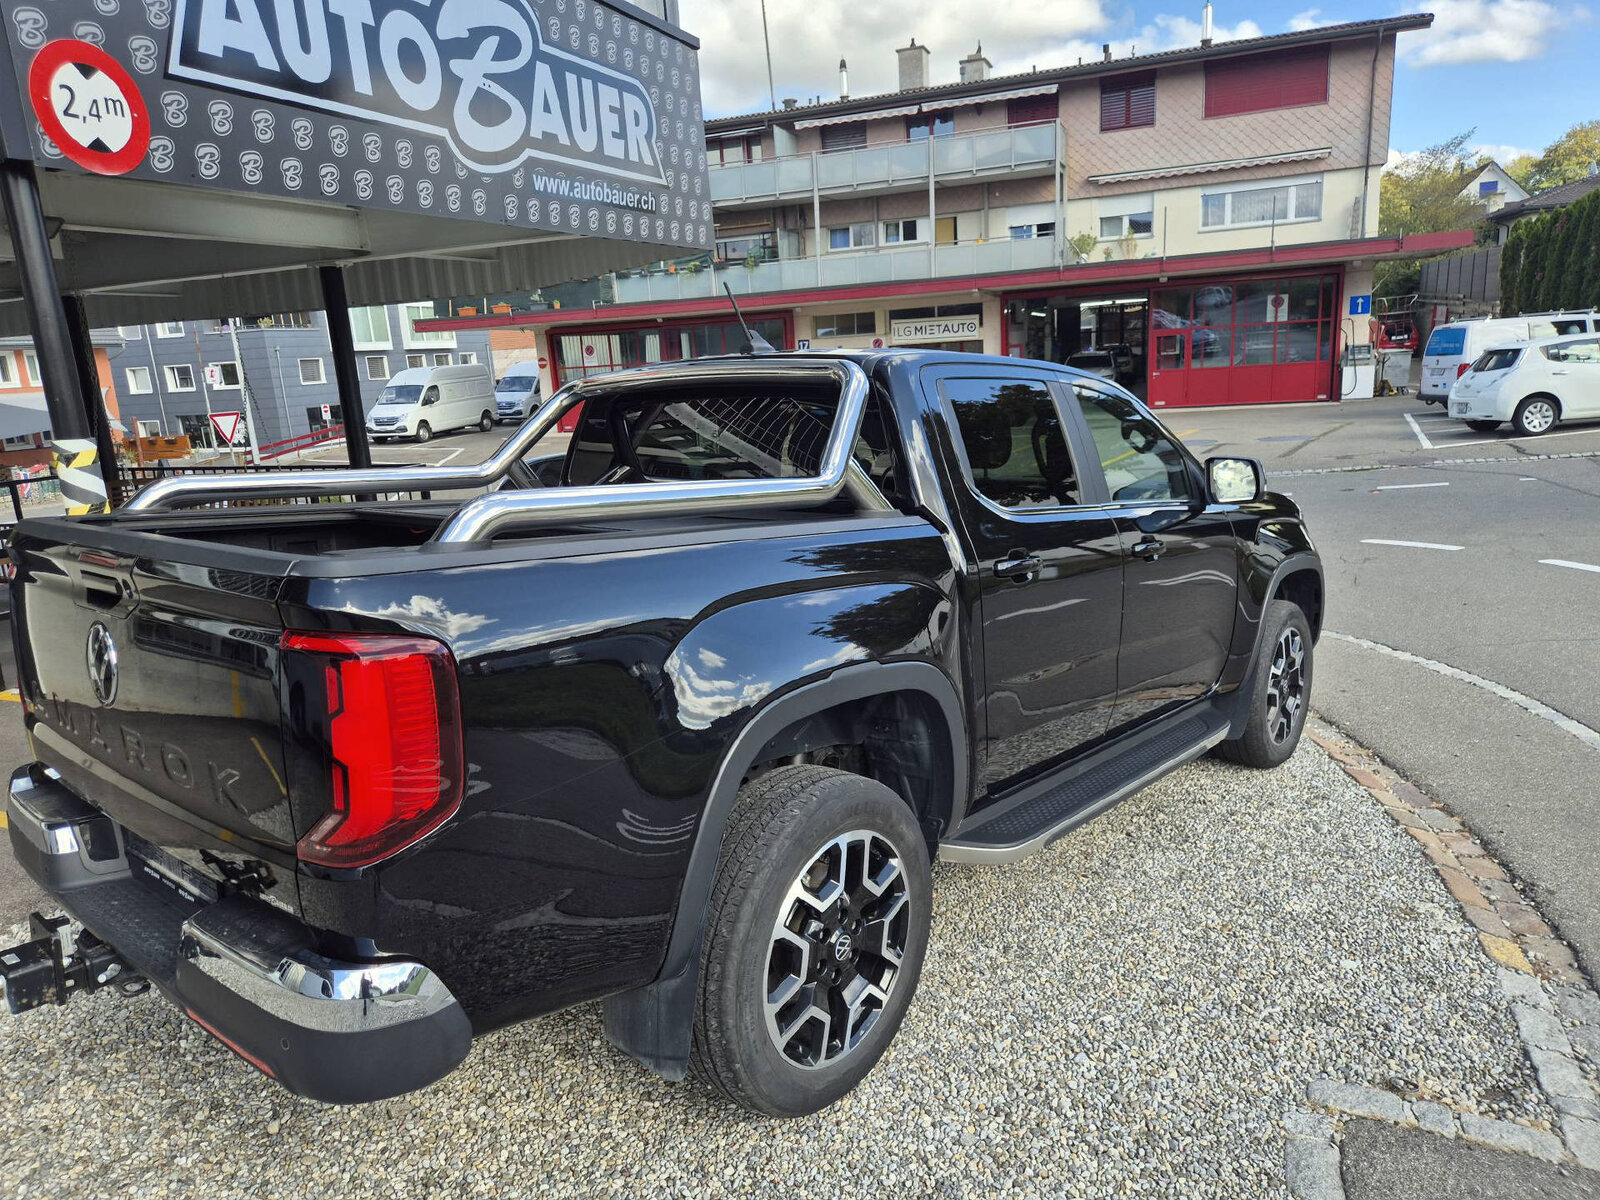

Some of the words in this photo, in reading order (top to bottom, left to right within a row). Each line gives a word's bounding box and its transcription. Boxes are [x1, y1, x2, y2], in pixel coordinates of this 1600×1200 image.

[197, 0, 443, 111] AUTO
[437, 0, 654, 167] BAUER
[532, 173, 656, 212] www.autobauer.ch
[914, 321, 977, 335] MIETAUTO
[798, 341, 809, 350] 17
